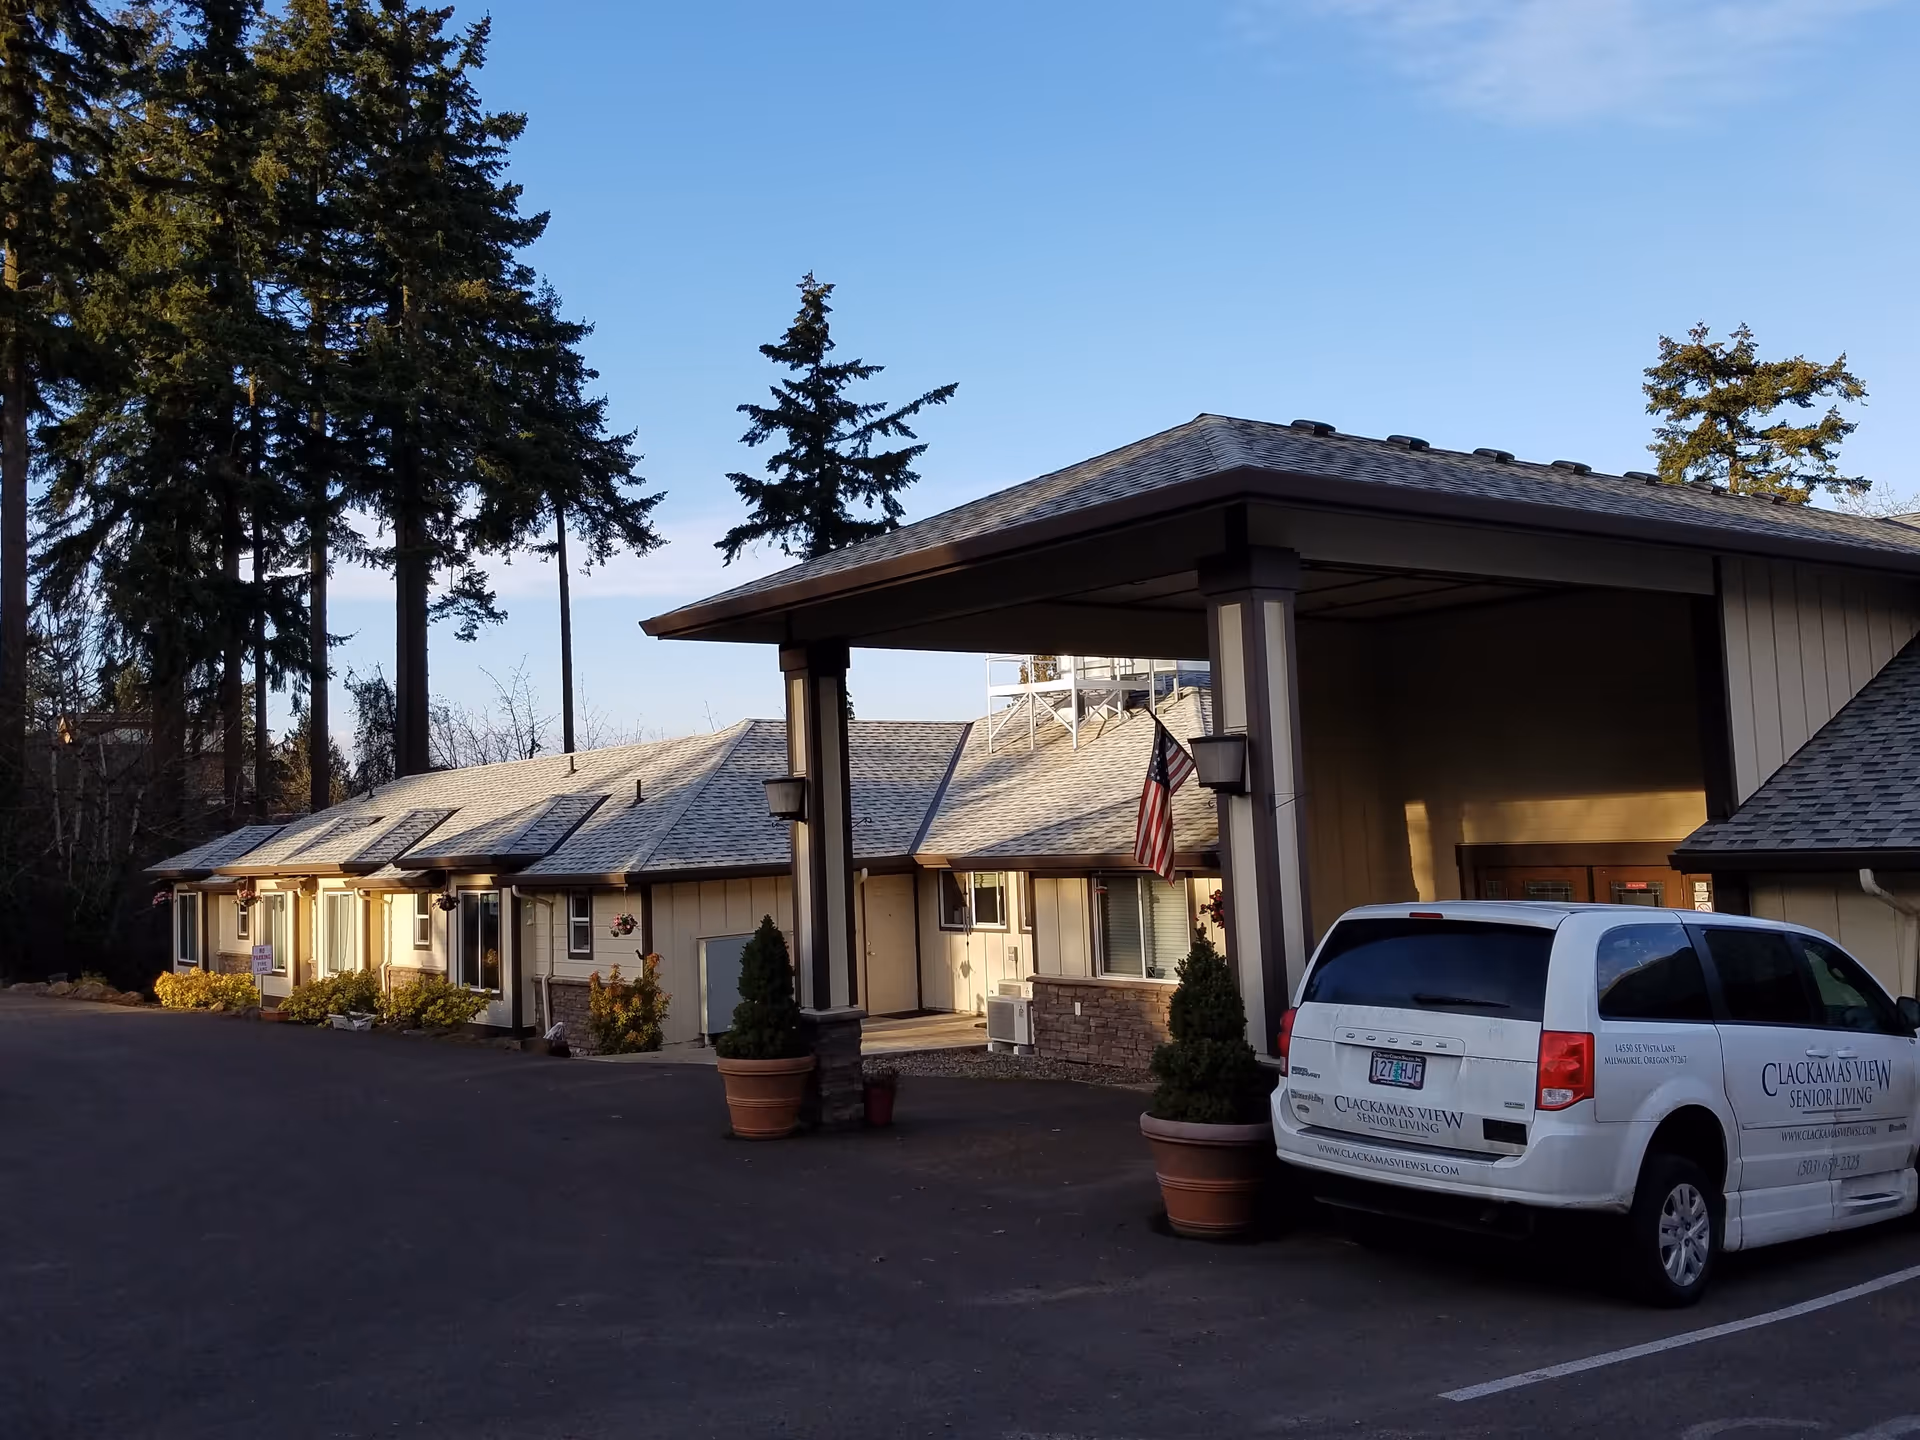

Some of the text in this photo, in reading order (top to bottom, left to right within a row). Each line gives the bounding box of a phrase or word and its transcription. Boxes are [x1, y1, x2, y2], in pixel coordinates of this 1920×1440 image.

[1374, 1059, 1422, 1082] 127 HJF
[1761, 1059, 1892, 1097] CLACKAMAS VIEW
[1789, 1086, 1872, 1109] SENIOR LIVING
[1334, 1095, 1464, 1129] CLACKAMAS VIEW
[1357, 1112, 1440, 1134] SENIOR LIVING
[1317, 1143, 1460, 1176] WWW.CLACKAMASVIEWSL.COM
